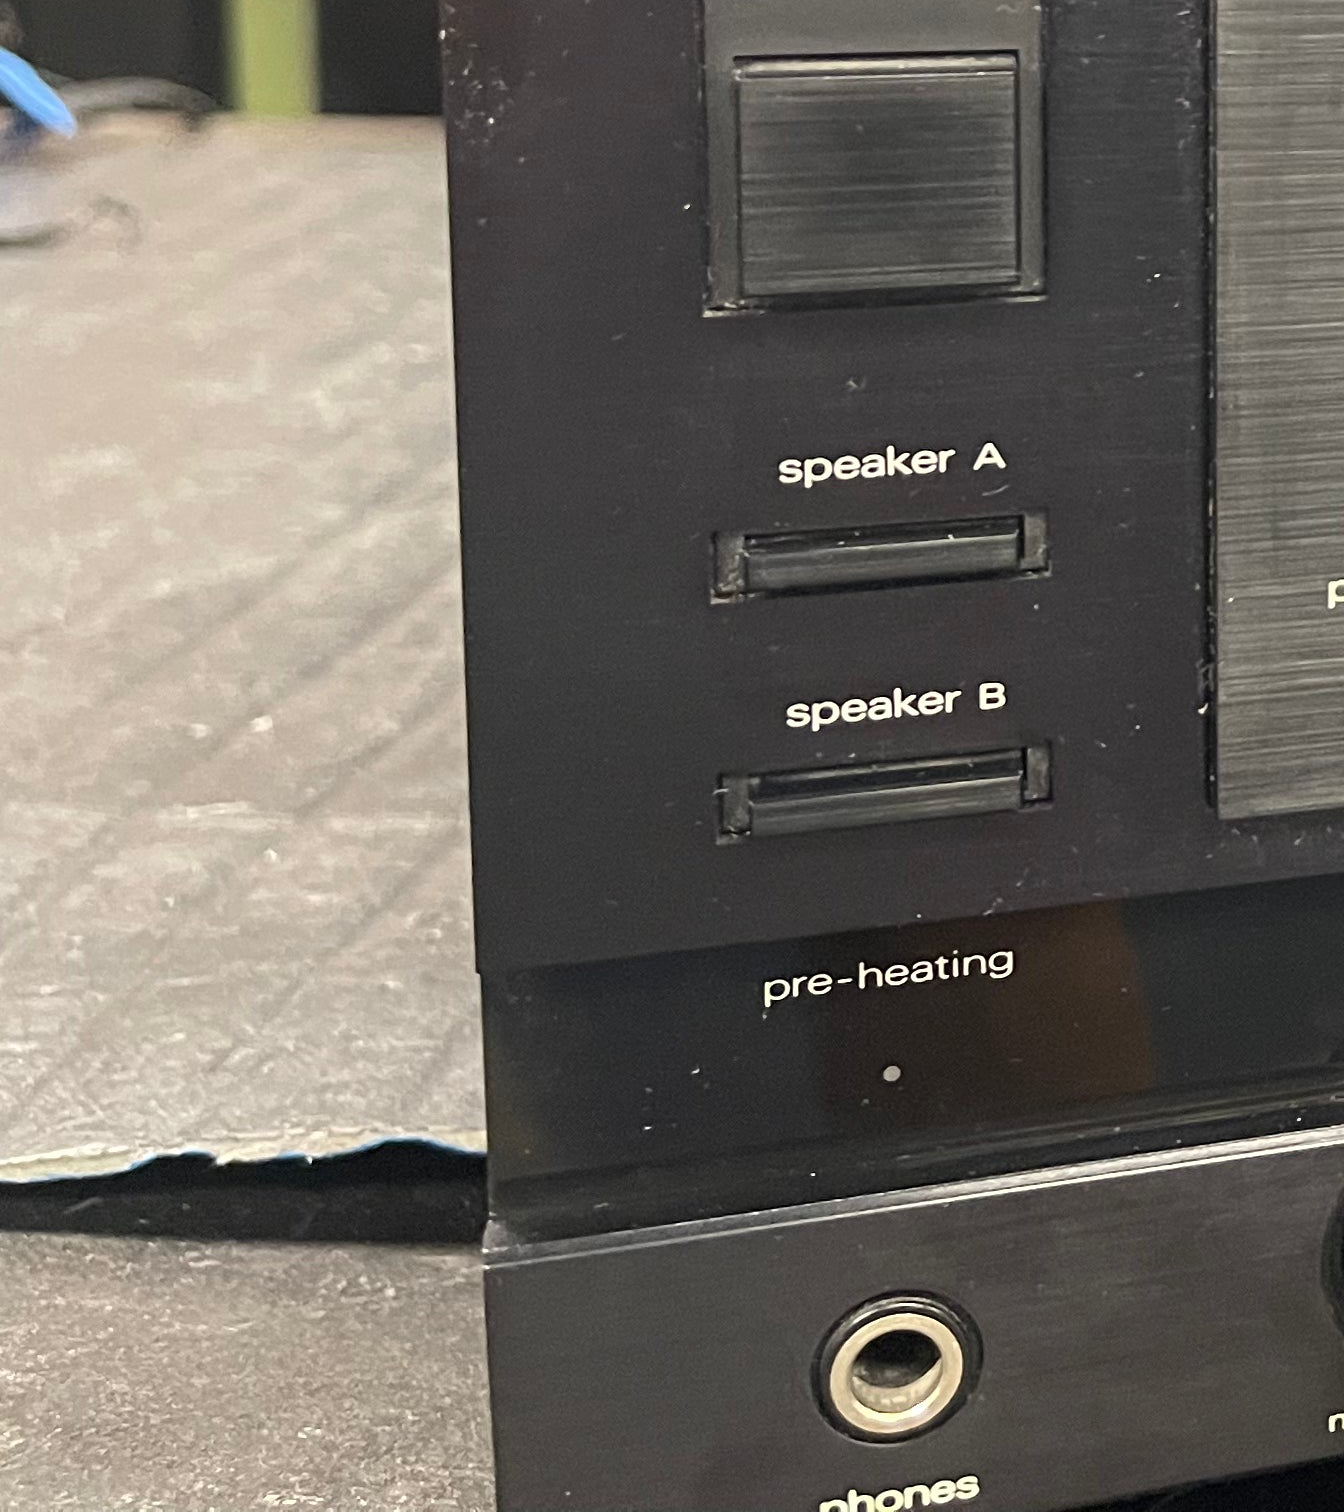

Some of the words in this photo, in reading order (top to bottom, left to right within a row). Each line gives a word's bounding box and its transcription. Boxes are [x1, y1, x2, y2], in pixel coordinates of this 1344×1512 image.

[777, 446, 956, 488] speaker
[972, 441, 1008, 471] A
[785, 688, 963, 732] speaker
[977, 681, 1008, 711] B
[763, 946, 1016, 1006] pre-heating
